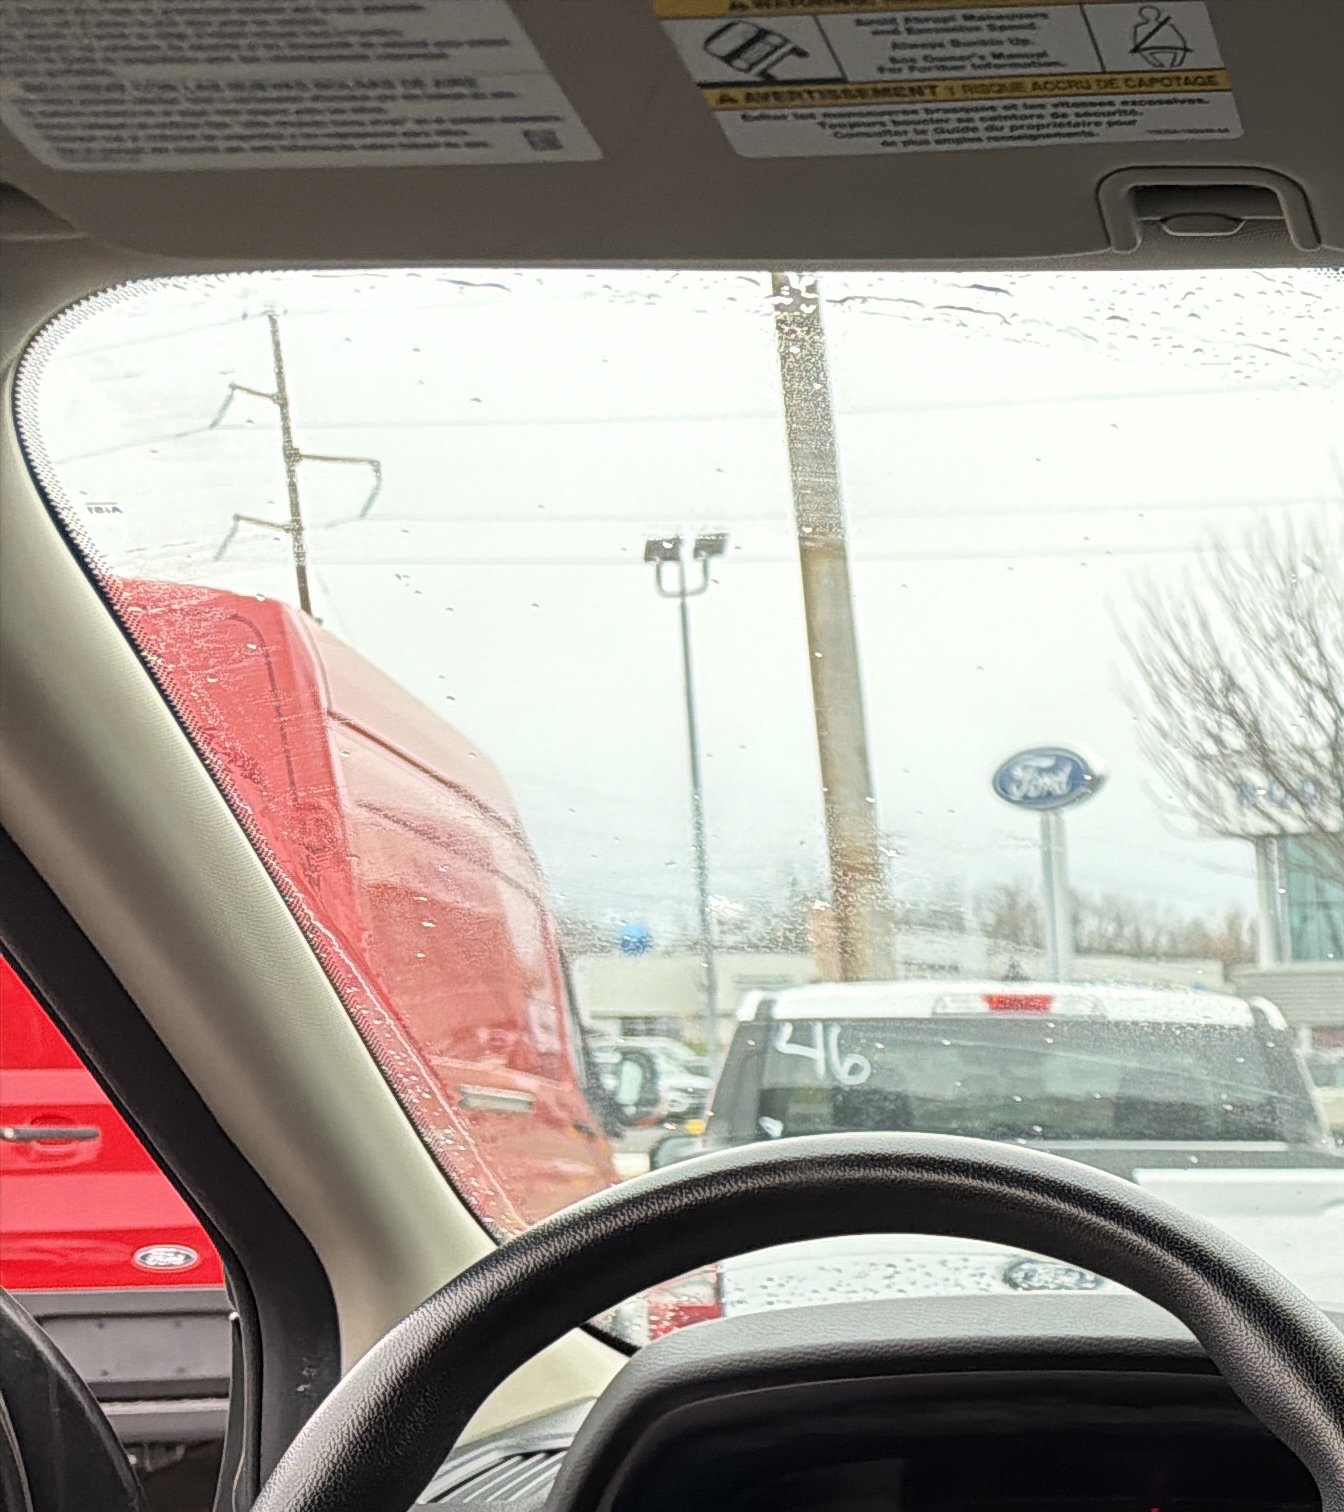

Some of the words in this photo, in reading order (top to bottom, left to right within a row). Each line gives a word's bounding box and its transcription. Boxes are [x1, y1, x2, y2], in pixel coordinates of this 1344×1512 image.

[1030, 77, 1092, 94] ACCRU
[1096, 76, 1121, 91] DE
[1125, 73, 1221, 90] CAPOTAGE
